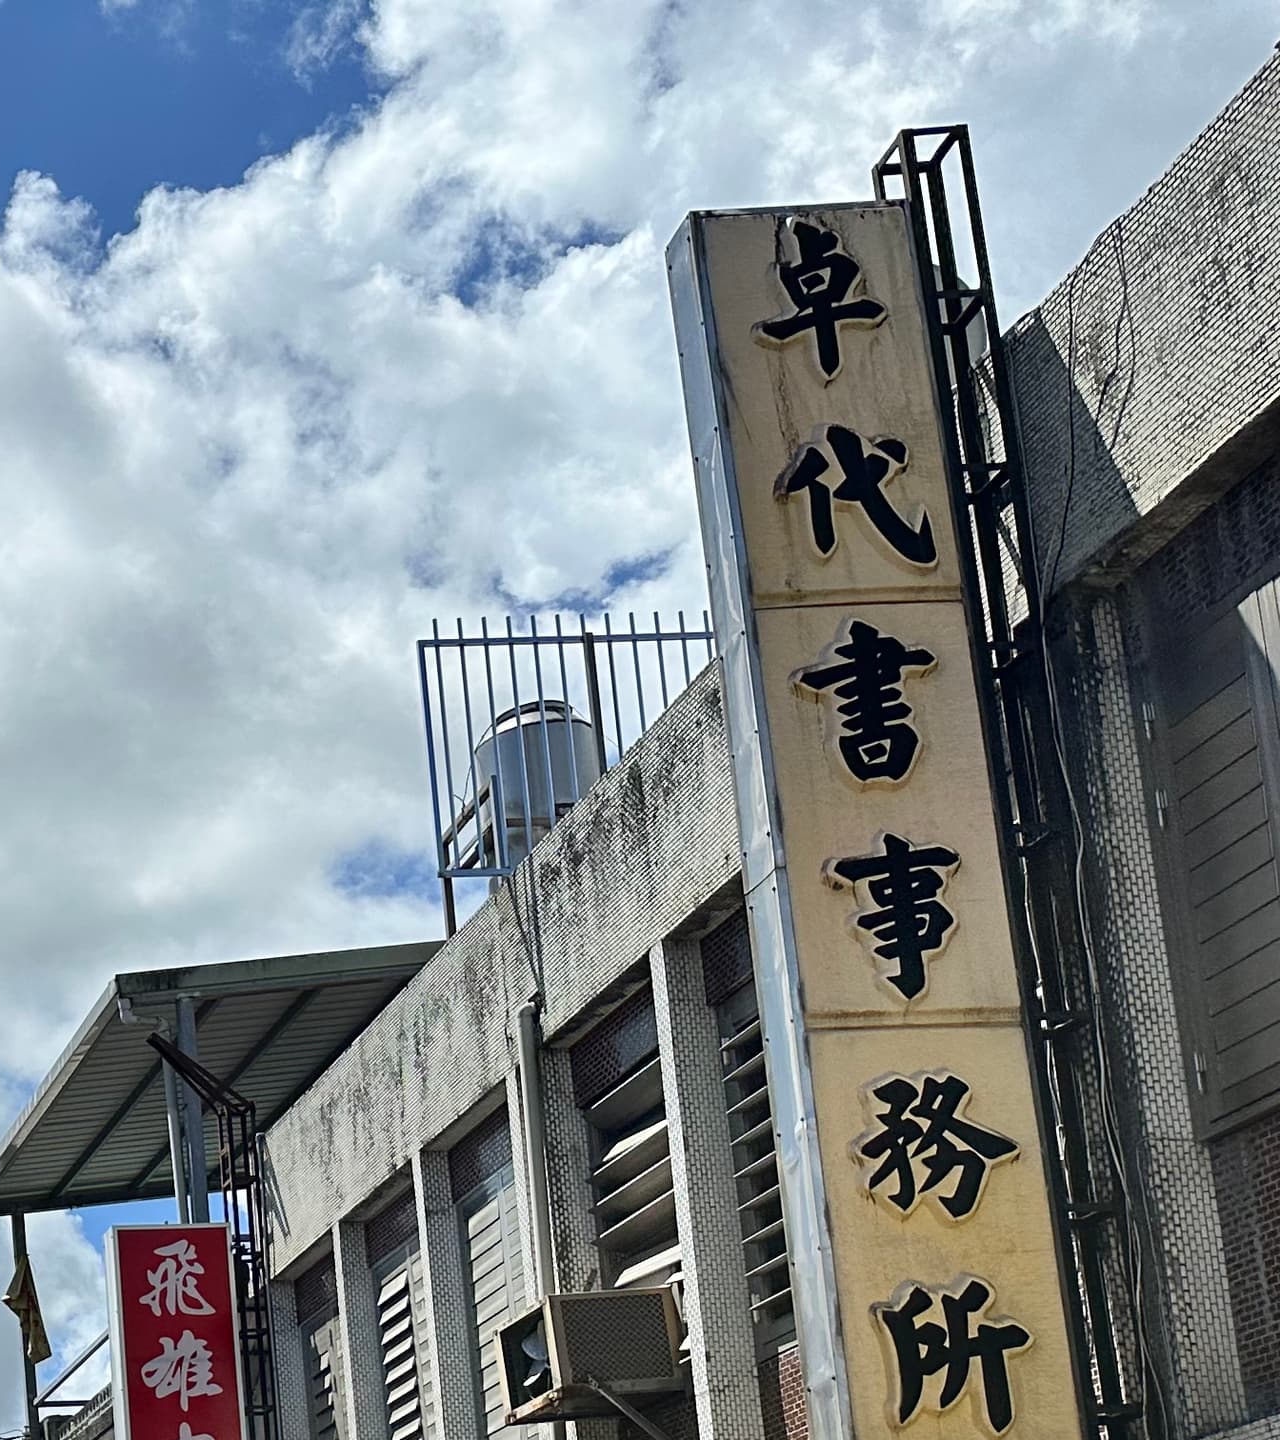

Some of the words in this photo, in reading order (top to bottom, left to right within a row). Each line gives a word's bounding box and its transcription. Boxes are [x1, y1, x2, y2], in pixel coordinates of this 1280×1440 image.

[752, 220, 1034, 1440] 卓代書事務所
